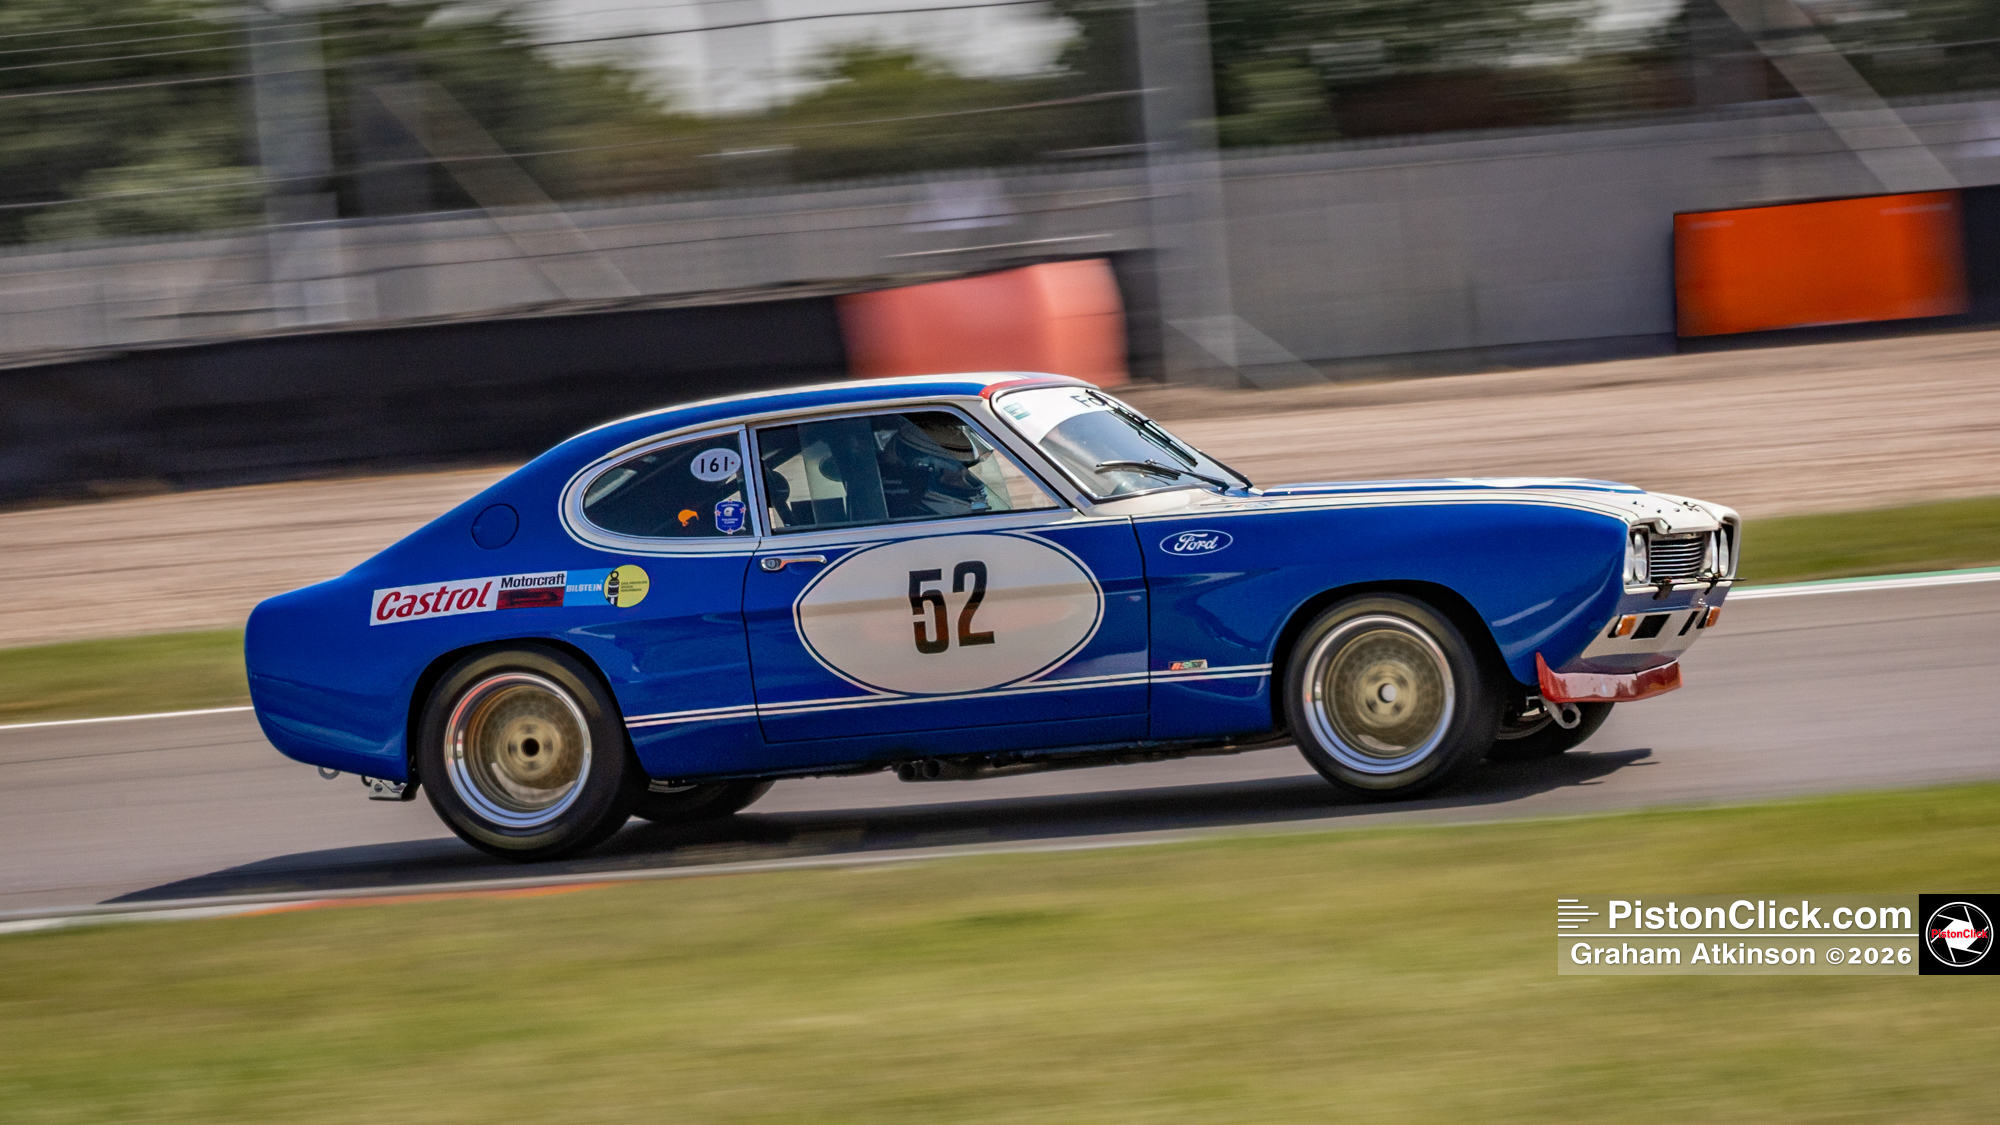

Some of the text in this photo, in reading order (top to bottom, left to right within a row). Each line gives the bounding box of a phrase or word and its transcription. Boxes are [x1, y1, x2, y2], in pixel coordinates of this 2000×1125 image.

[1174, 533, 1219, 552] Ford
[500, 573, 566, 588] Motorcraft
[566, 583, 603, 593] BILSTEIN
[376, 581, 493, 620] Castrol
[908, 560, 995, 654] 52
